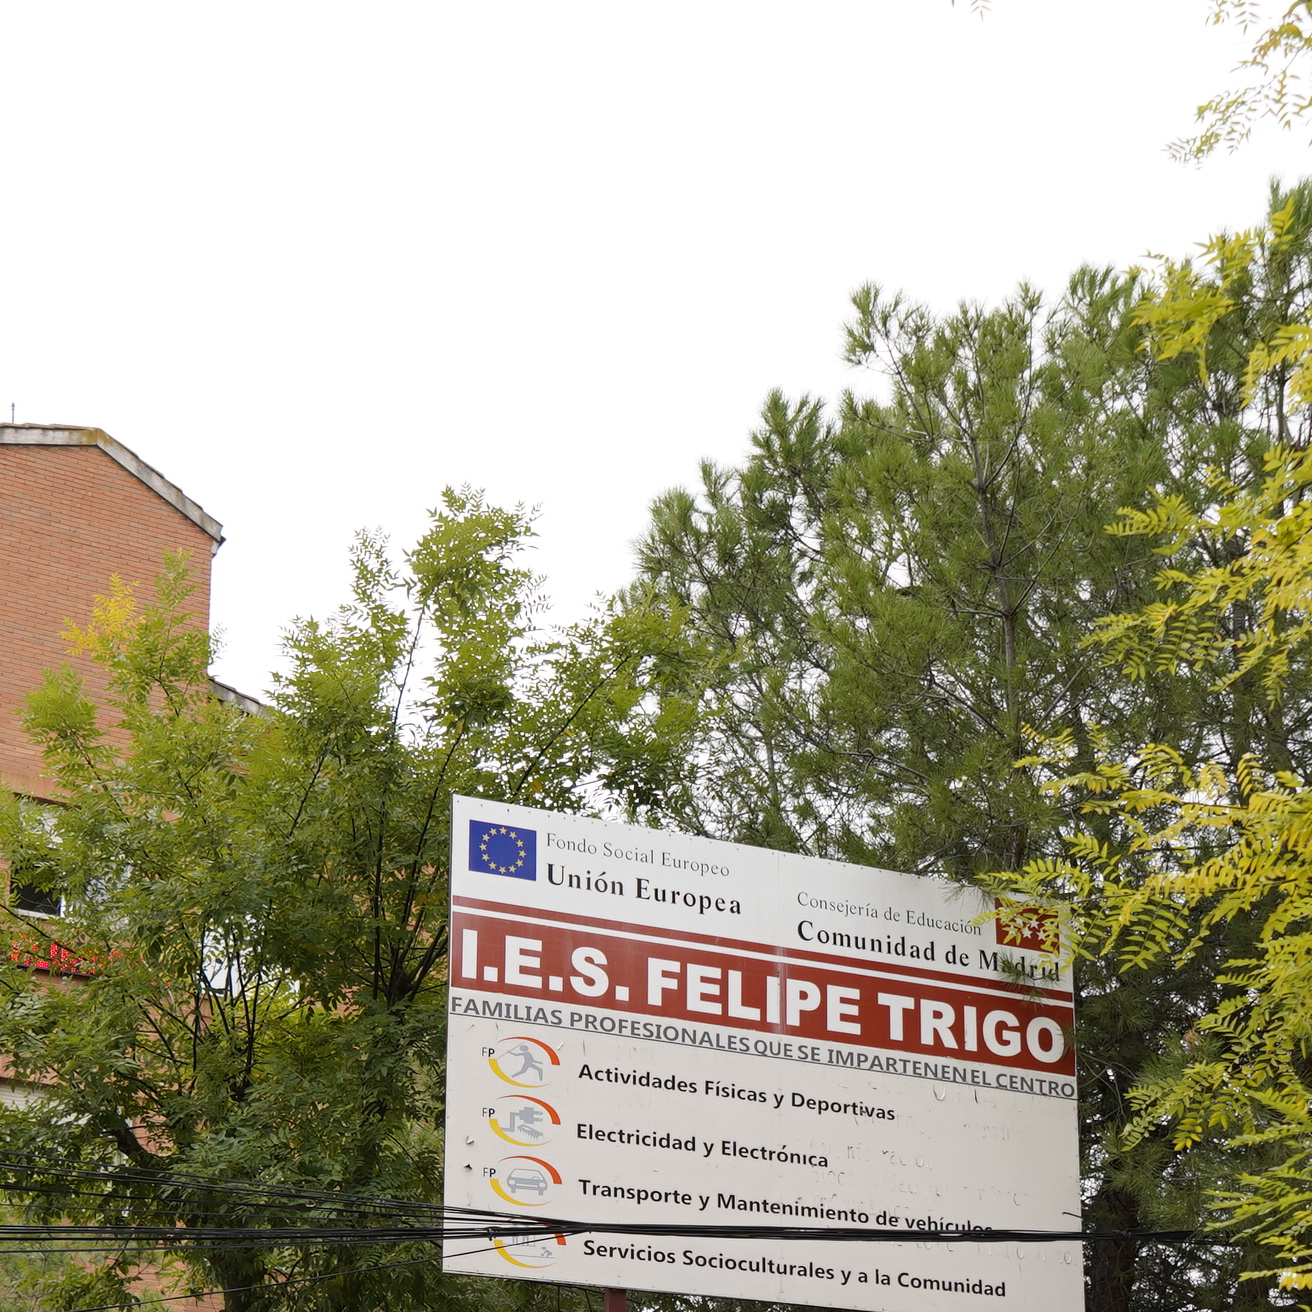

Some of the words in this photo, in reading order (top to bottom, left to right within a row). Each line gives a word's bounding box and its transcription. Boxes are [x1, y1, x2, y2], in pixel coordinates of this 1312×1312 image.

[546, 833, 597, 855] Fondo
[603, 842, 654, 864] Social
[662, 852, 730, 877] Europeo
[546, 863, 624, 896] Unión
[635, 877, 742, 915] Europea
[797, 891, 879, 921] Consejería
[884, 907, 901, 922] de
[906, 910, 982, 936] Educación
[797, 920, 936, 962] Comunidad
[944, 946, 970, 967] de
[978, 949, 1060, 981] Mdrid
[461, 929, 630, 1002] I.E.S.
[647, 957, 862, 1036] FELIPE
[877, 992, 1065, 1064] TRIGO
[451, 996, 562, 1026] FAMILIAS
[569, 1012, 750, 1052] PROFESIONALES
[754, 1039, 793, 1059] QUE
[797, 1045, 821, 1062] SE
[971, 1070, 991, 1086] EL
[995, 1073, 1075, 1098] CENTRO
[481, 1047, 496, 1058] FP
[481, 1107, 496, 1118] FP
[578, 1064, 698, 1094] Actividades
[704, 1081, 767, 1104] Físicas
[773, 1093, 784, 1109] y
[791, 1092, 896, 1121] Deportivas
[576, 1124, 696, 1152] Electricidad
[703, 1143, 714, 1158] y
[721, 1141, 828, 1168] Electrónica
[482, 1167, 497, 1178] FP
[578, 1179, 692, 1206] Transporte
[698, 1196, 710, 1211] y
[717, 1193, 869, 1224] Mantenimiento
[876, 1211, 899, 1227] de
[905, 1215, 993, 1232] vehícul
[583, 1240, 676, 1264] Servicios
[682, 1250, 835, 1280] Socioculturales
[840, 1269, 852, 1285] y
[857, 1272, 868, 1284] a
[875, 1269, 890, 1286] la
[897, 1272, 1006, 1297] Comunidad
